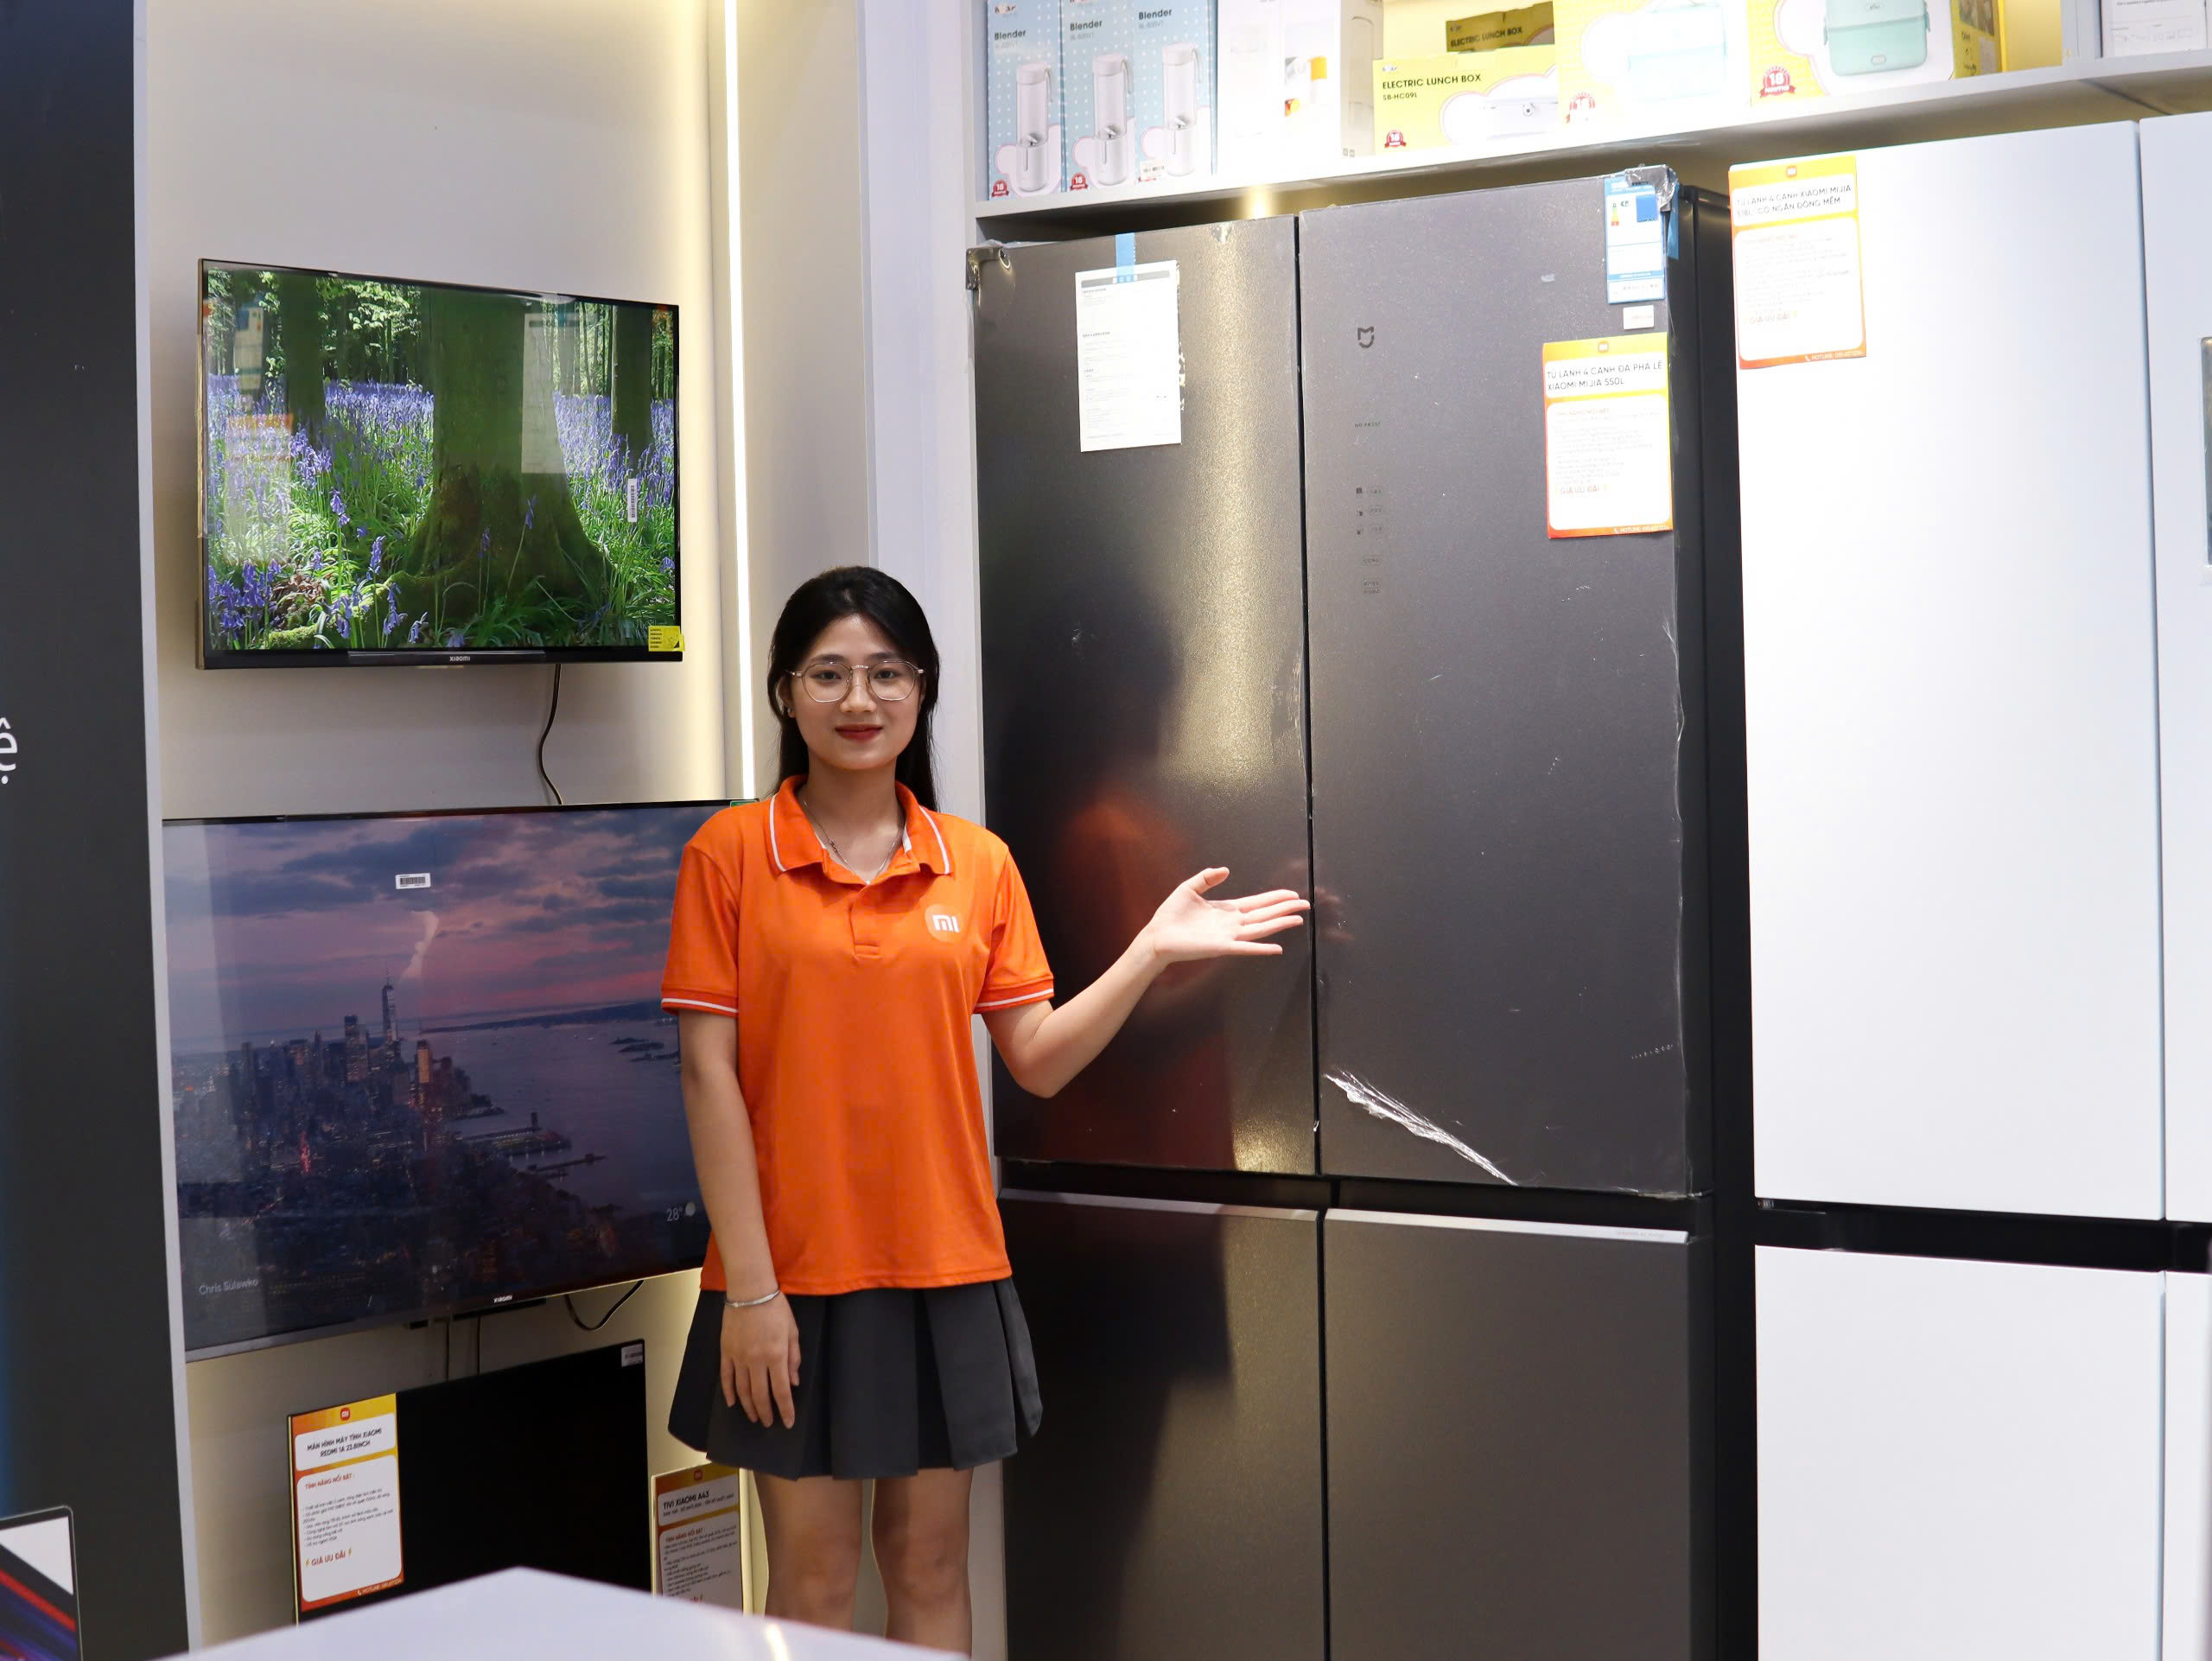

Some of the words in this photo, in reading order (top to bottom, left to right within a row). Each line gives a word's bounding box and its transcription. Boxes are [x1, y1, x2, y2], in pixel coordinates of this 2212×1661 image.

[1139, 8, 1173, 20] Blender
[1070, 20, 1103, 31] Blender
[1506, 26, 1523, 36] BOX
[995, 29, 1026, 40] Blender
[1382, 79, 1424, 89] ELECTRIC
[1427, 76, 1459, 86] LUNCH
[1461, 73, 1481, 83] BOX
[1769, 72, 1784, 86] 18
[1074, 175, 1084, 184] 18
[1800, 188, 1827, 199] XIAOMI
[1829, 184, 1852, 195] MIJIA
[1633, 360, 1650, 370] PHA
[1548, 381, 1577, 391] XIAOMI
[1579, 378, 1602, 388] MIJIA
[199, 1282, 222, 1295] Chris
[675, 1494, 697, 1507] XIAOMI
